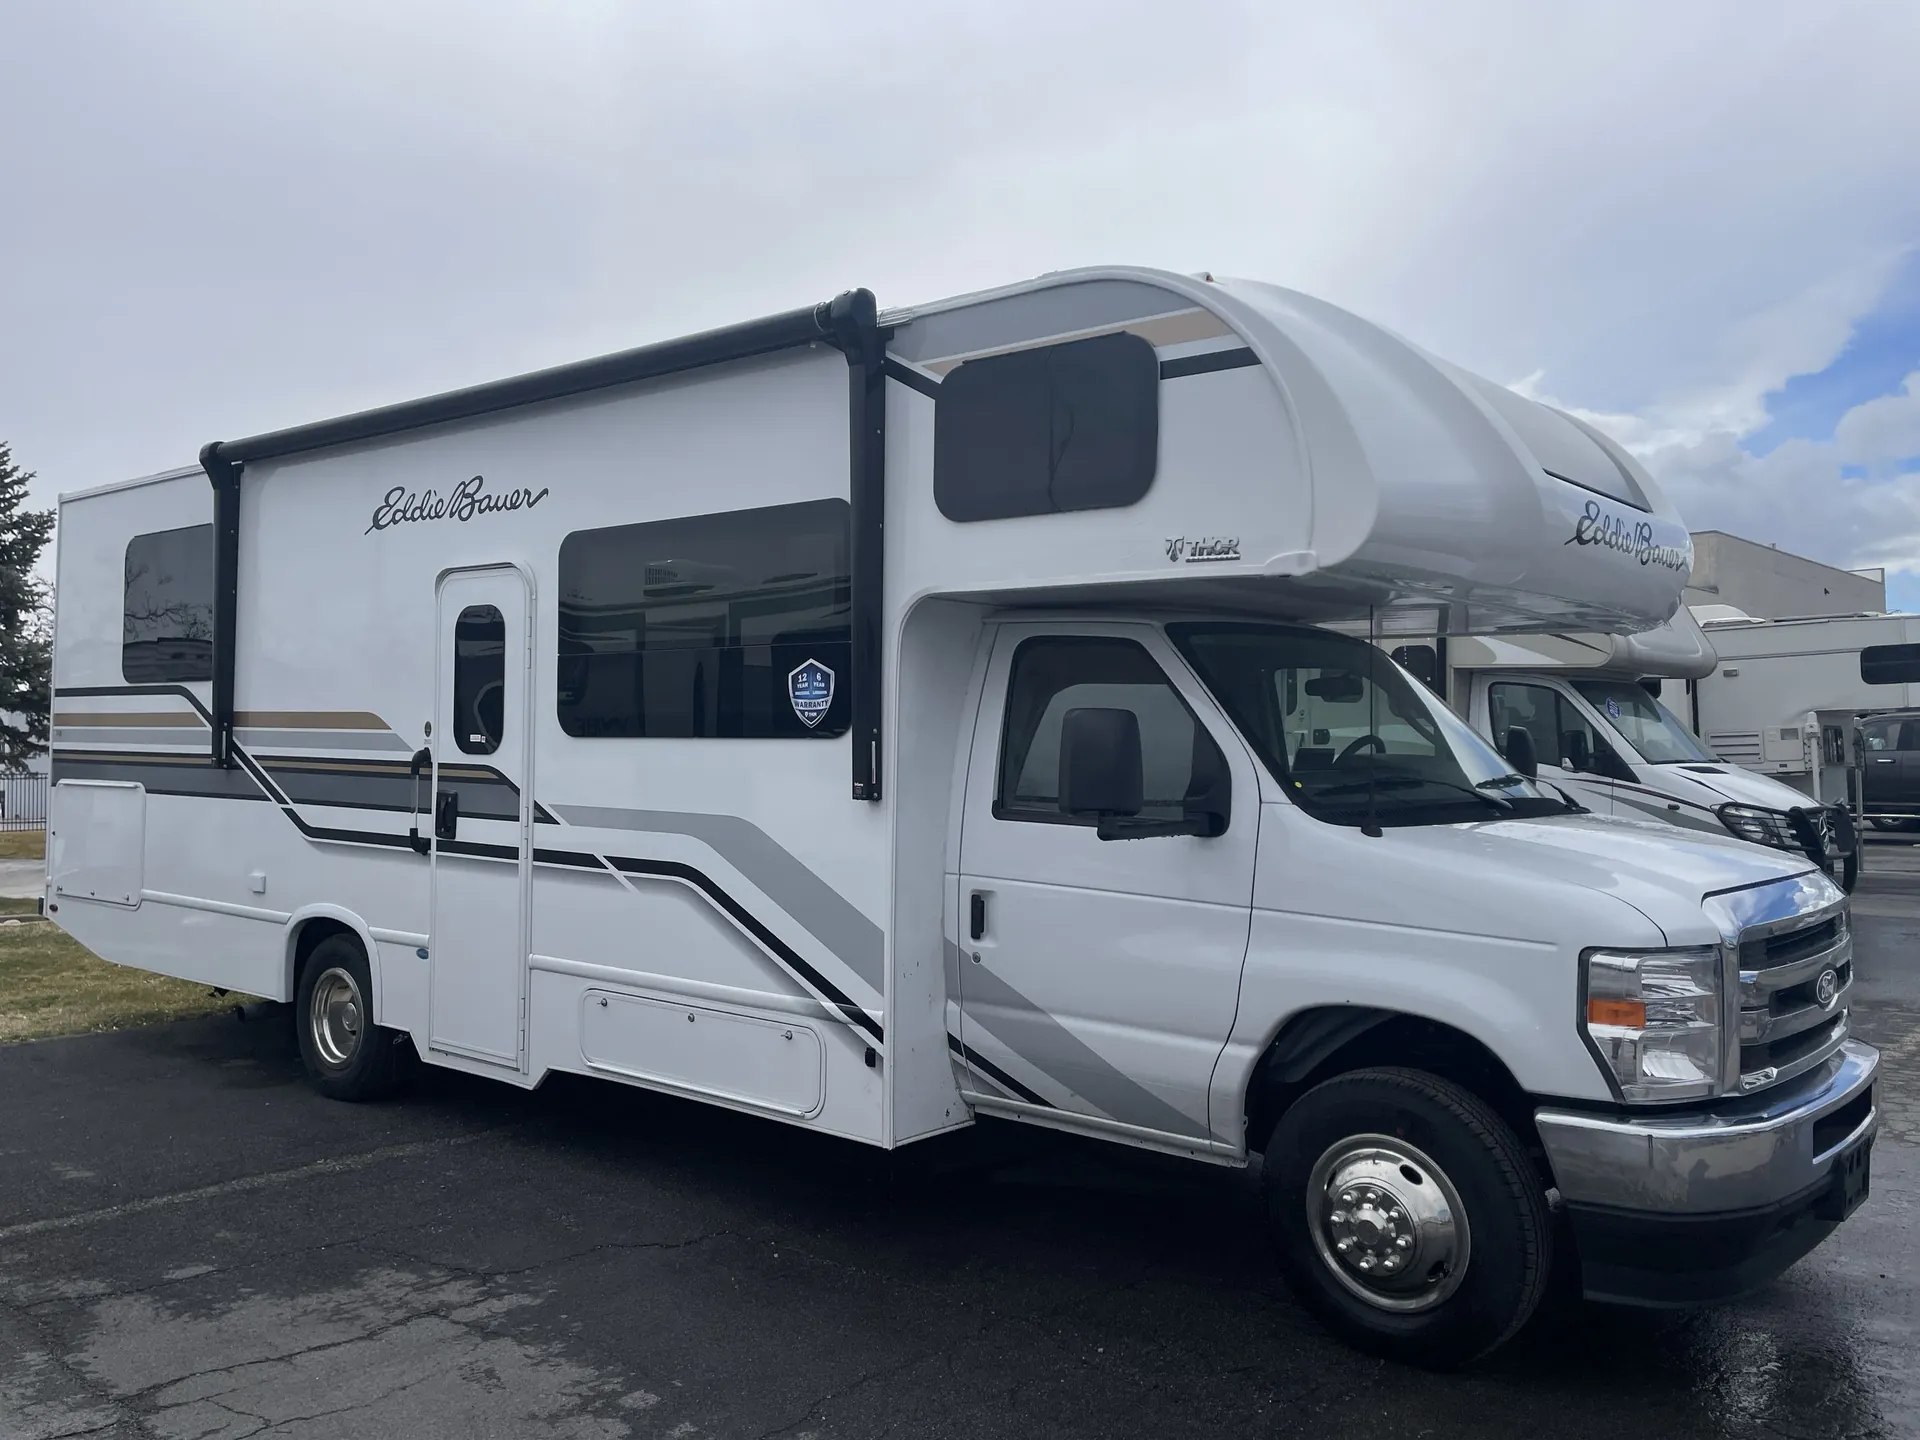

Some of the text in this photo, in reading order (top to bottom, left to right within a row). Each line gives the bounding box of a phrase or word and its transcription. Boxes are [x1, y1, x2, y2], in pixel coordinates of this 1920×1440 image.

[365, 475, 549, 536] Eddie Bauer
[1564, 500, 1688, 572] Eddie Bauer
[1185, 536, 1241, 556] THOR
[798, 672, 808, 683] 12
[816, 672, 822, 682] 6
[794, 700, 828, 709] WARRANTY
